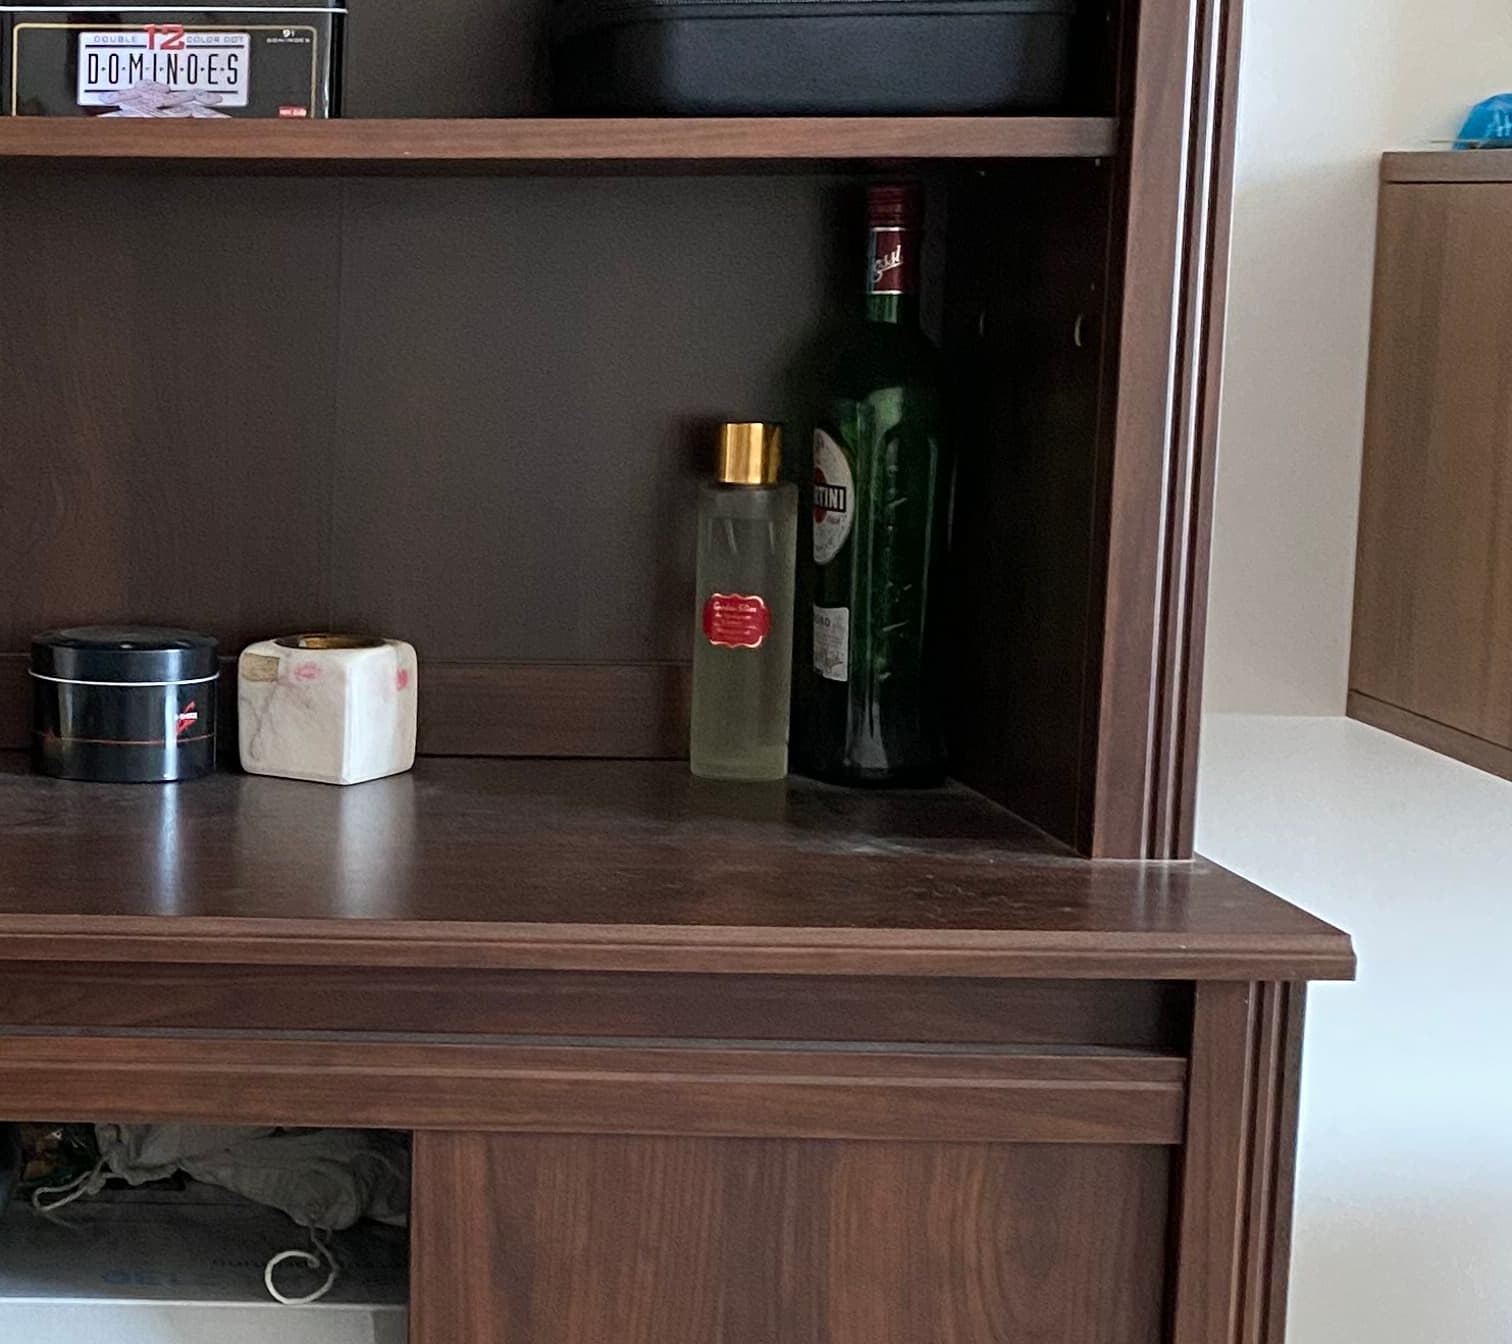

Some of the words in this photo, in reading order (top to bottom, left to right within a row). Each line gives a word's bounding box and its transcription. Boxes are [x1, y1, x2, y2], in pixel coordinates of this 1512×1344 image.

[93, 35, 137, 43] DOUBLE
[186, 35, 220, 43] COLOR
[143, 23, 185, 50] 12
